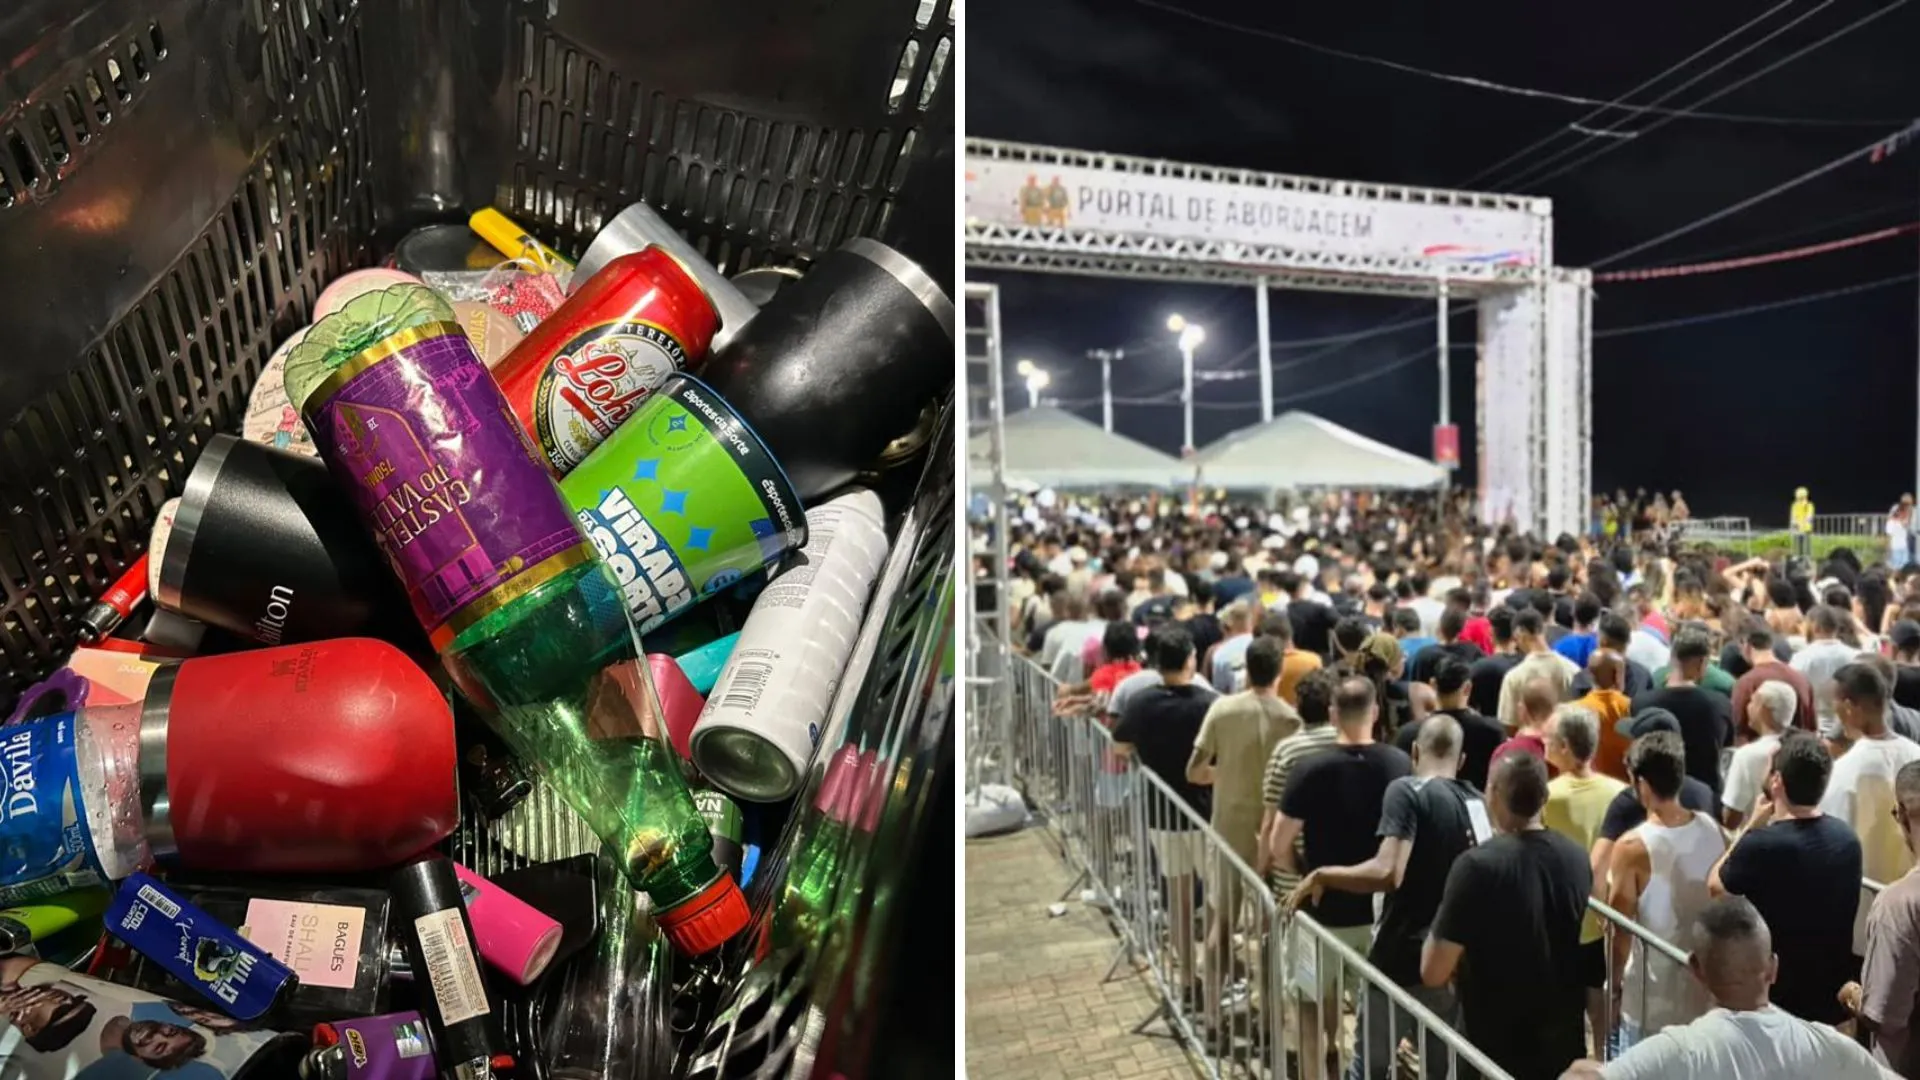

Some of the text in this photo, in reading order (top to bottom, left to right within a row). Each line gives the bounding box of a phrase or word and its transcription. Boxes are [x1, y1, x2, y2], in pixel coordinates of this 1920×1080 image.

[1078, 185, 1177, 221] PORTAL
[1187, 195, 1217, 223] DE
[419, 464, 450, 492] DO
[9, 730, 38, 820] Dávila
[126, 903, 149, 931] COOL
